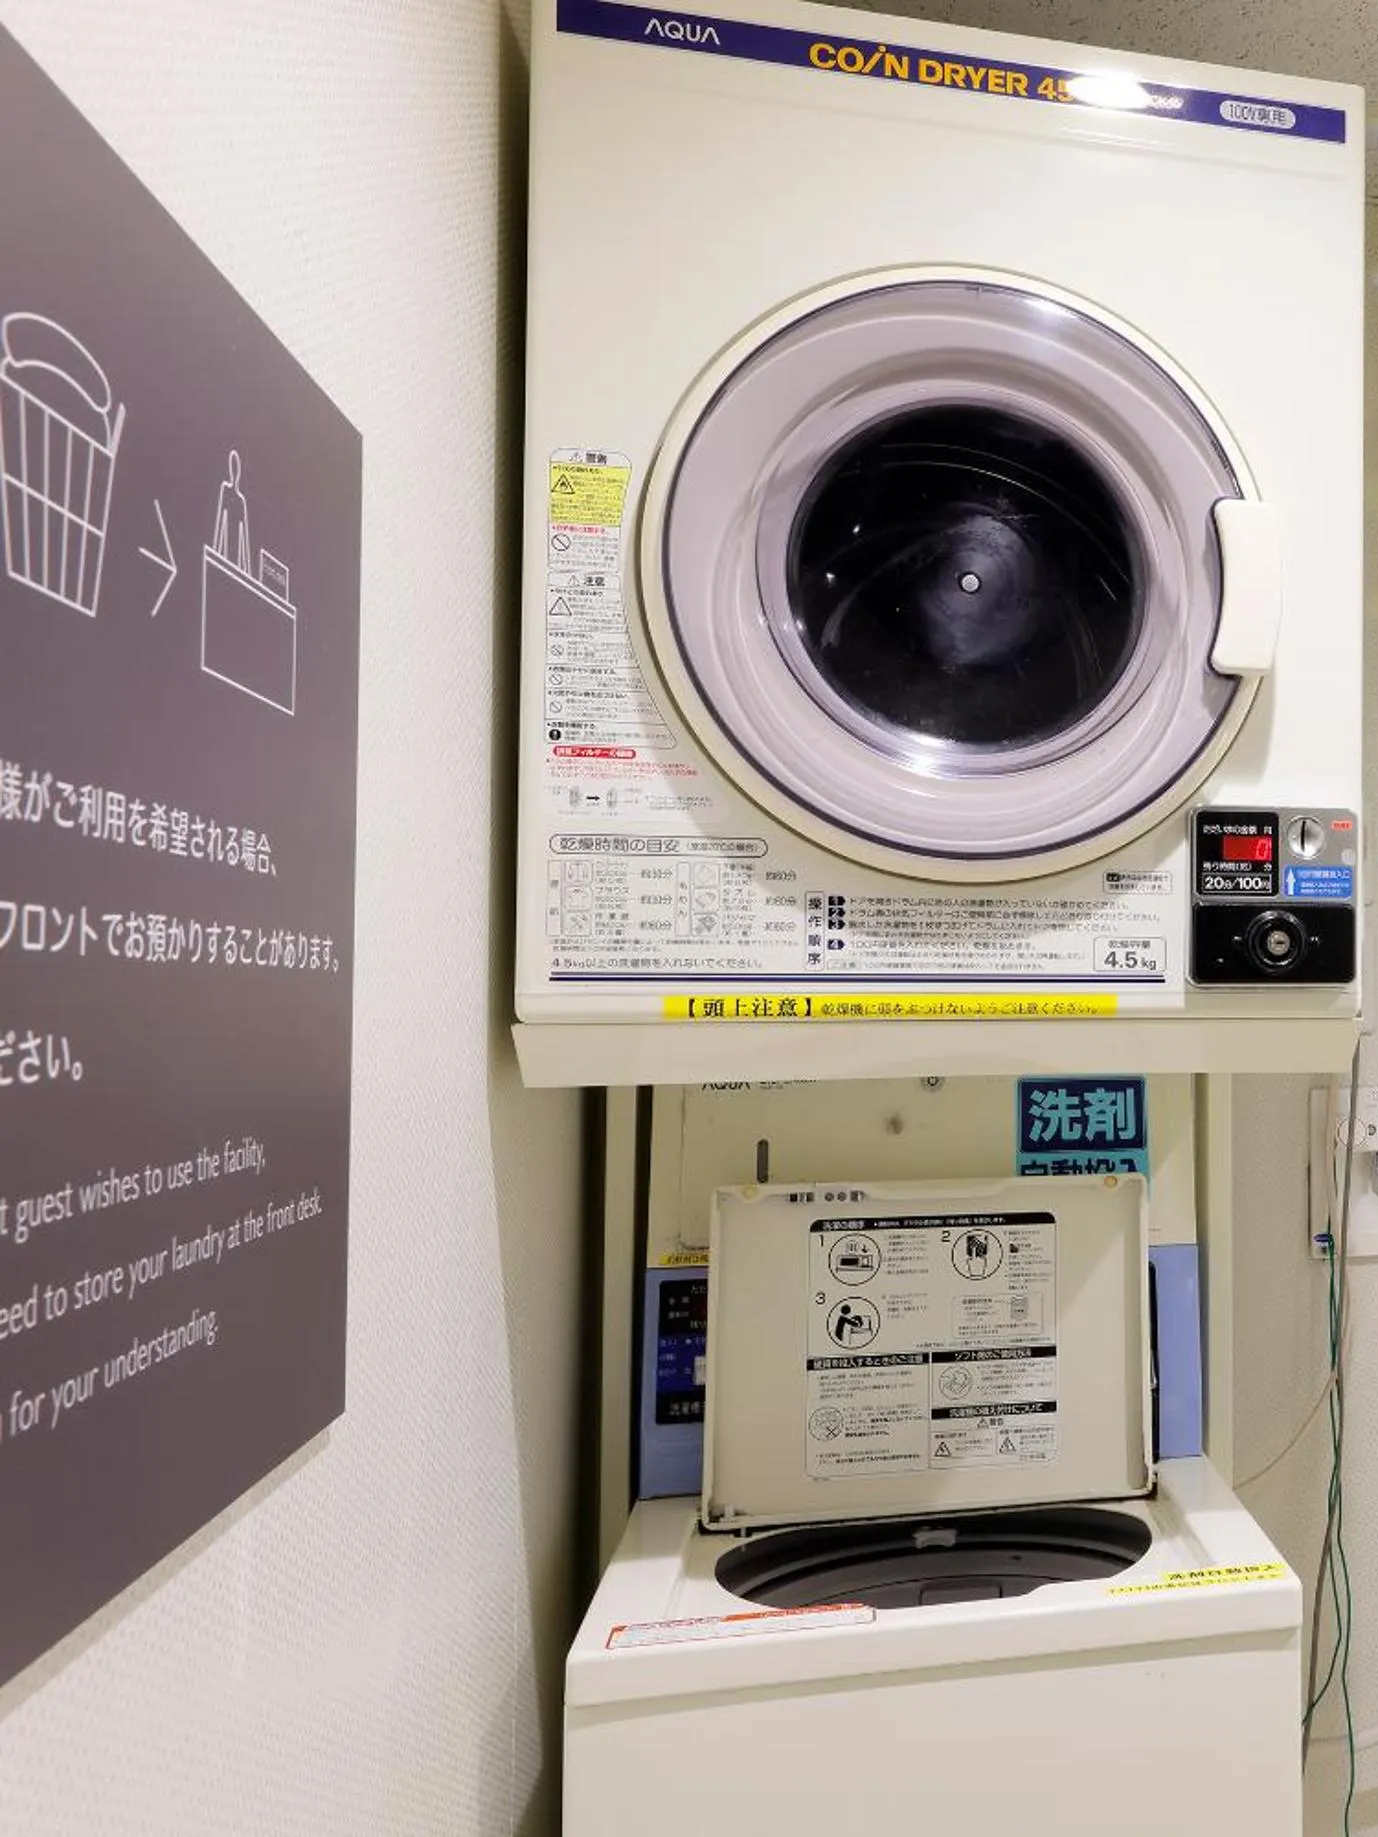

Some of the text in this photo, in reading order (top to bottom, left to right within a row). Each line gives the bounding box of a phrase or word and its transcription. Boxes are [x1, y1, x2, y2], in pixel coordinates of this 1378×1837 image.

[643, 18, 721, 46] AQUA
[918, 58, 1028, 97] DRYER
[1028, 1087, 1136, 1142] 洗剤
[14, 1182, 74, 1244] guest
[79, 1167, 141, 1214] wishes
[144, 1164, 163, 1196] to
[167, 1160, 193, 1189] use
[197, 1147, 220, 1182] the
[941, 1230, 951, 1242] 2
[43, 1285, 68, 1320] to
[74, 1266, 124, 1309] store
[129, 1250, 168, 1300] your
[171, 1224, 225, 1272] laundry
[227, 1218, 240, 1250] at
[243, 1209, 264, 1242] the
[266, 1201, 295, 1233] front
[815, 1292, 826, 1305] 3
[9, 1390, 45, 1438] for
[50, 1368, 99, 1430] your
